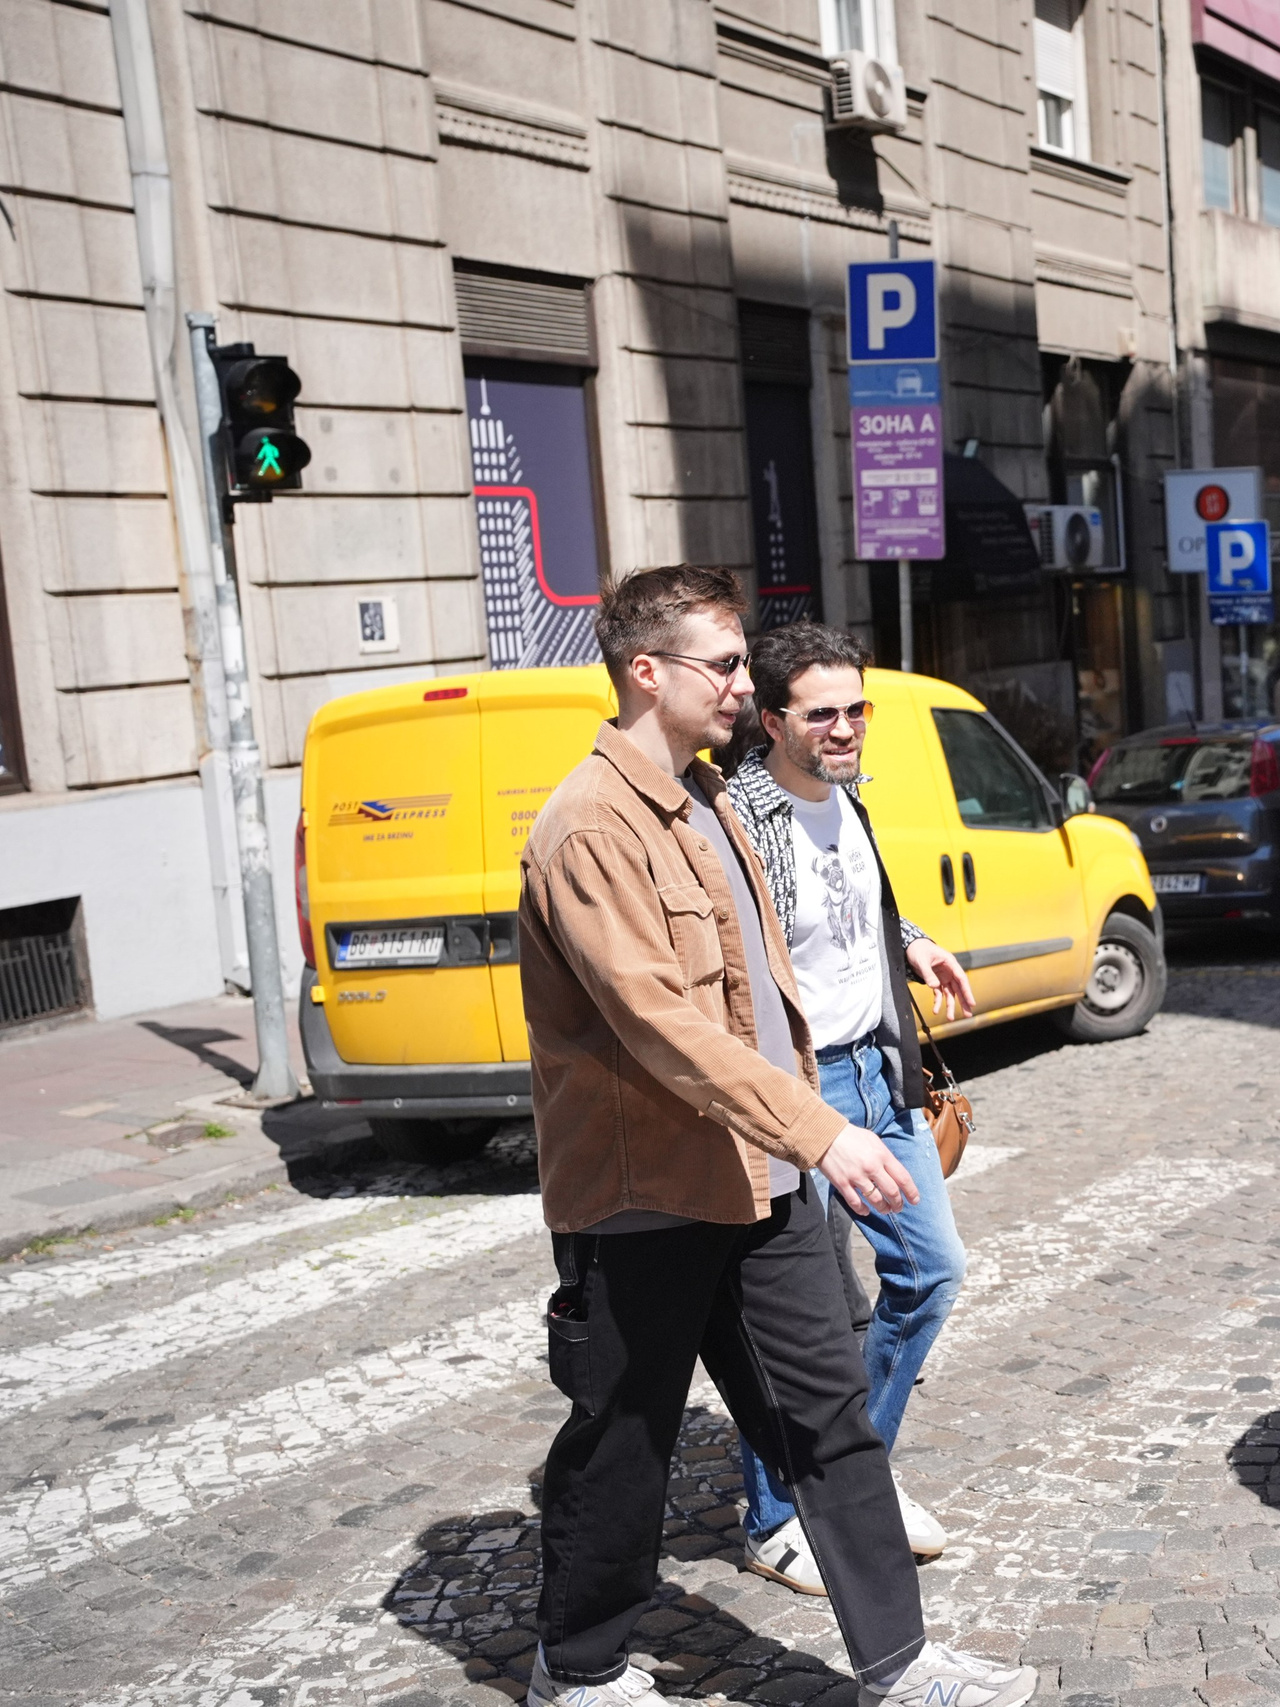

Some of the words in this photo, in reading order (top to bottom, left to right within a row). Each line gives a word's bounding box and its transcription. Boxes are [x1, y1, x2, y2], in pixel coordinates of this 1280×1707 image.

[867, 272, 917, 350] P
[860, 414, 915, 435] ЗОНА
[920, 413, 935, 433] А
[1218, 529, 1256, 586] P
[332, 801, 359, 811] POST
[394, 808, 447, 821] EXPRESS
[511, 810, 538, 821] 0800
[387, 832, 414, 840] BRZINU
[511, 826, 530, 837] 011
[350, 933, 369, 956] BG
